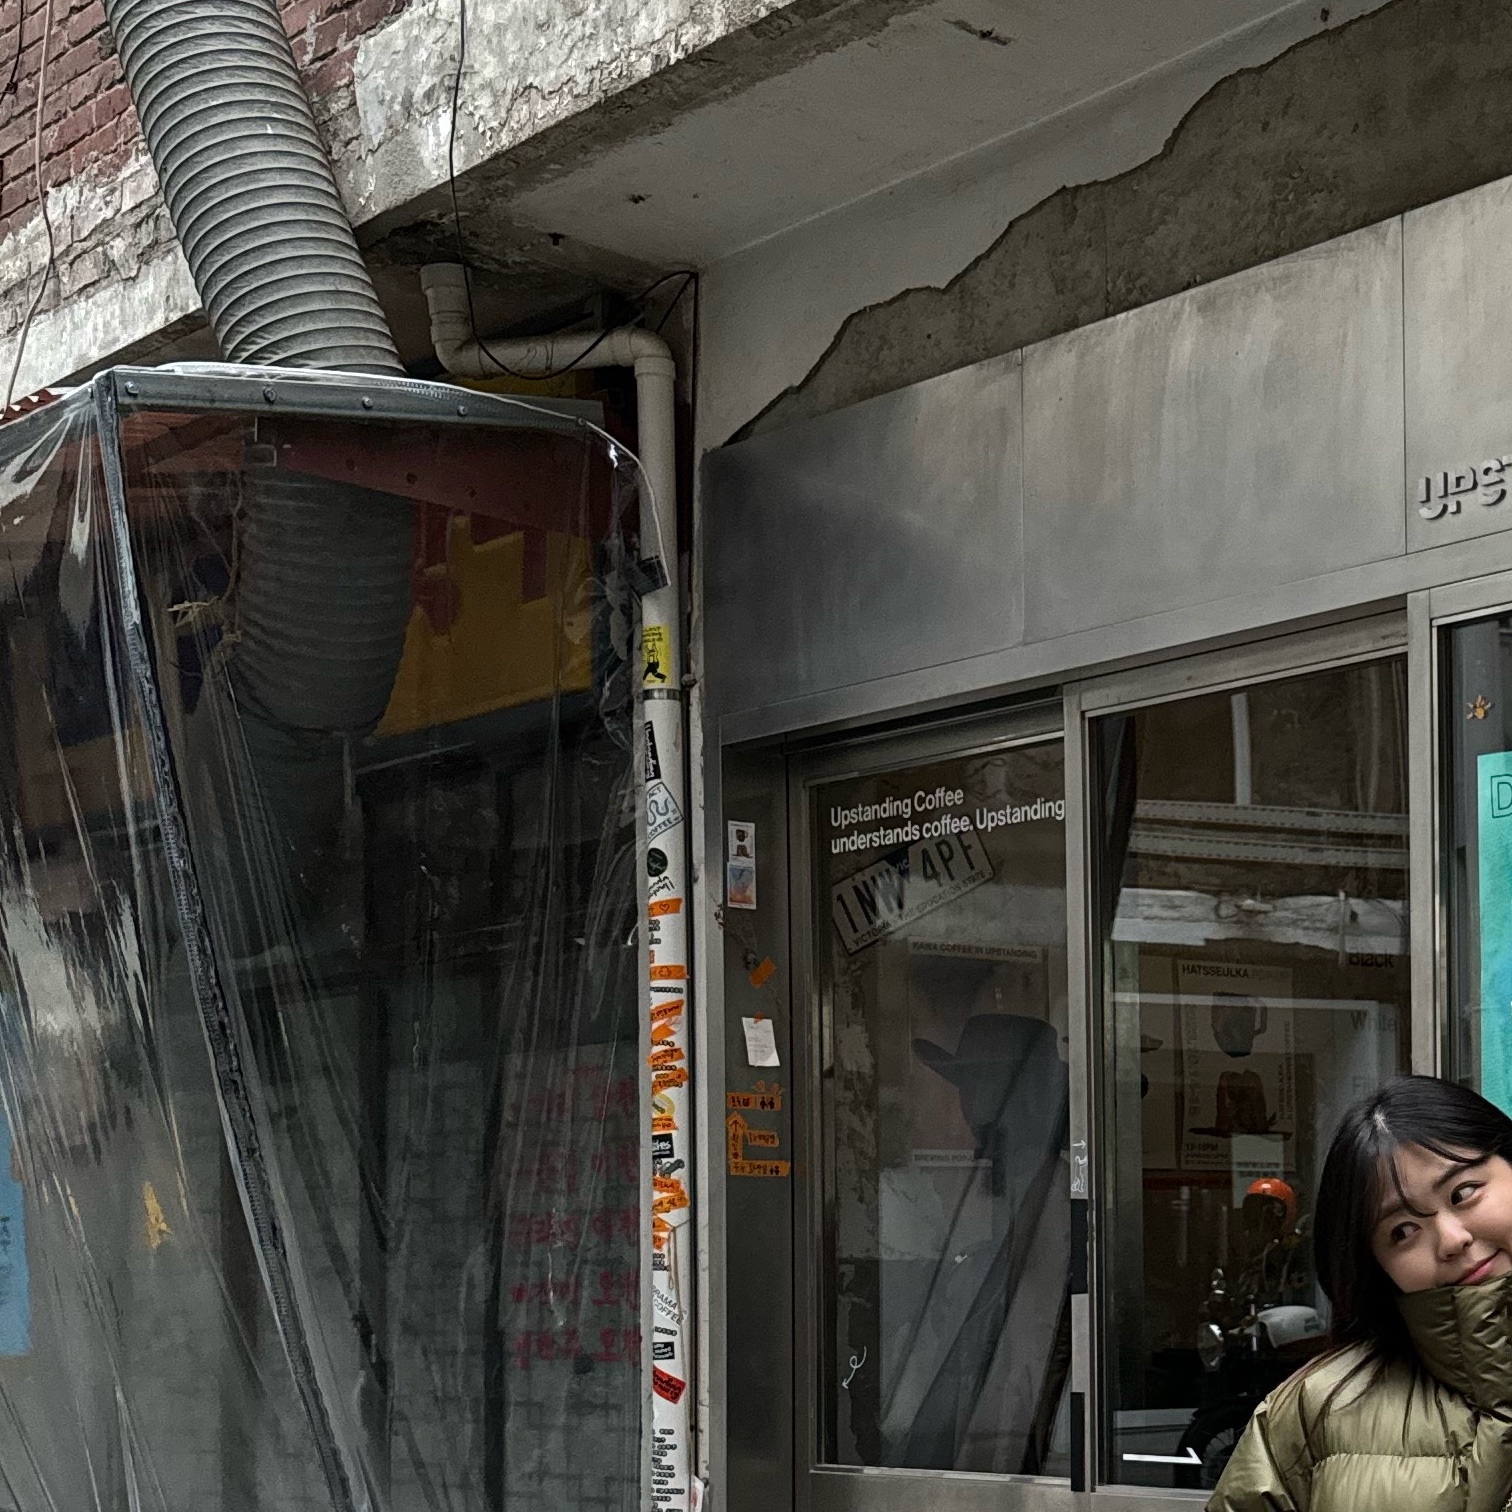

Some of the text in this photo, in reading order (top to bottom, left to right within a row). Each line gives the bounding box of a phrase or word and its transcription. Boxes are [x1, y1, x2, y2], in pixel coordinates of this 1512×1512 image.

[831, 786, 964, 830] Upstanding Coffee
[831, 797, 1066, 854] understands coffee. Upstanding
[1182, 963, 1250, 979] HATSSEULKA
